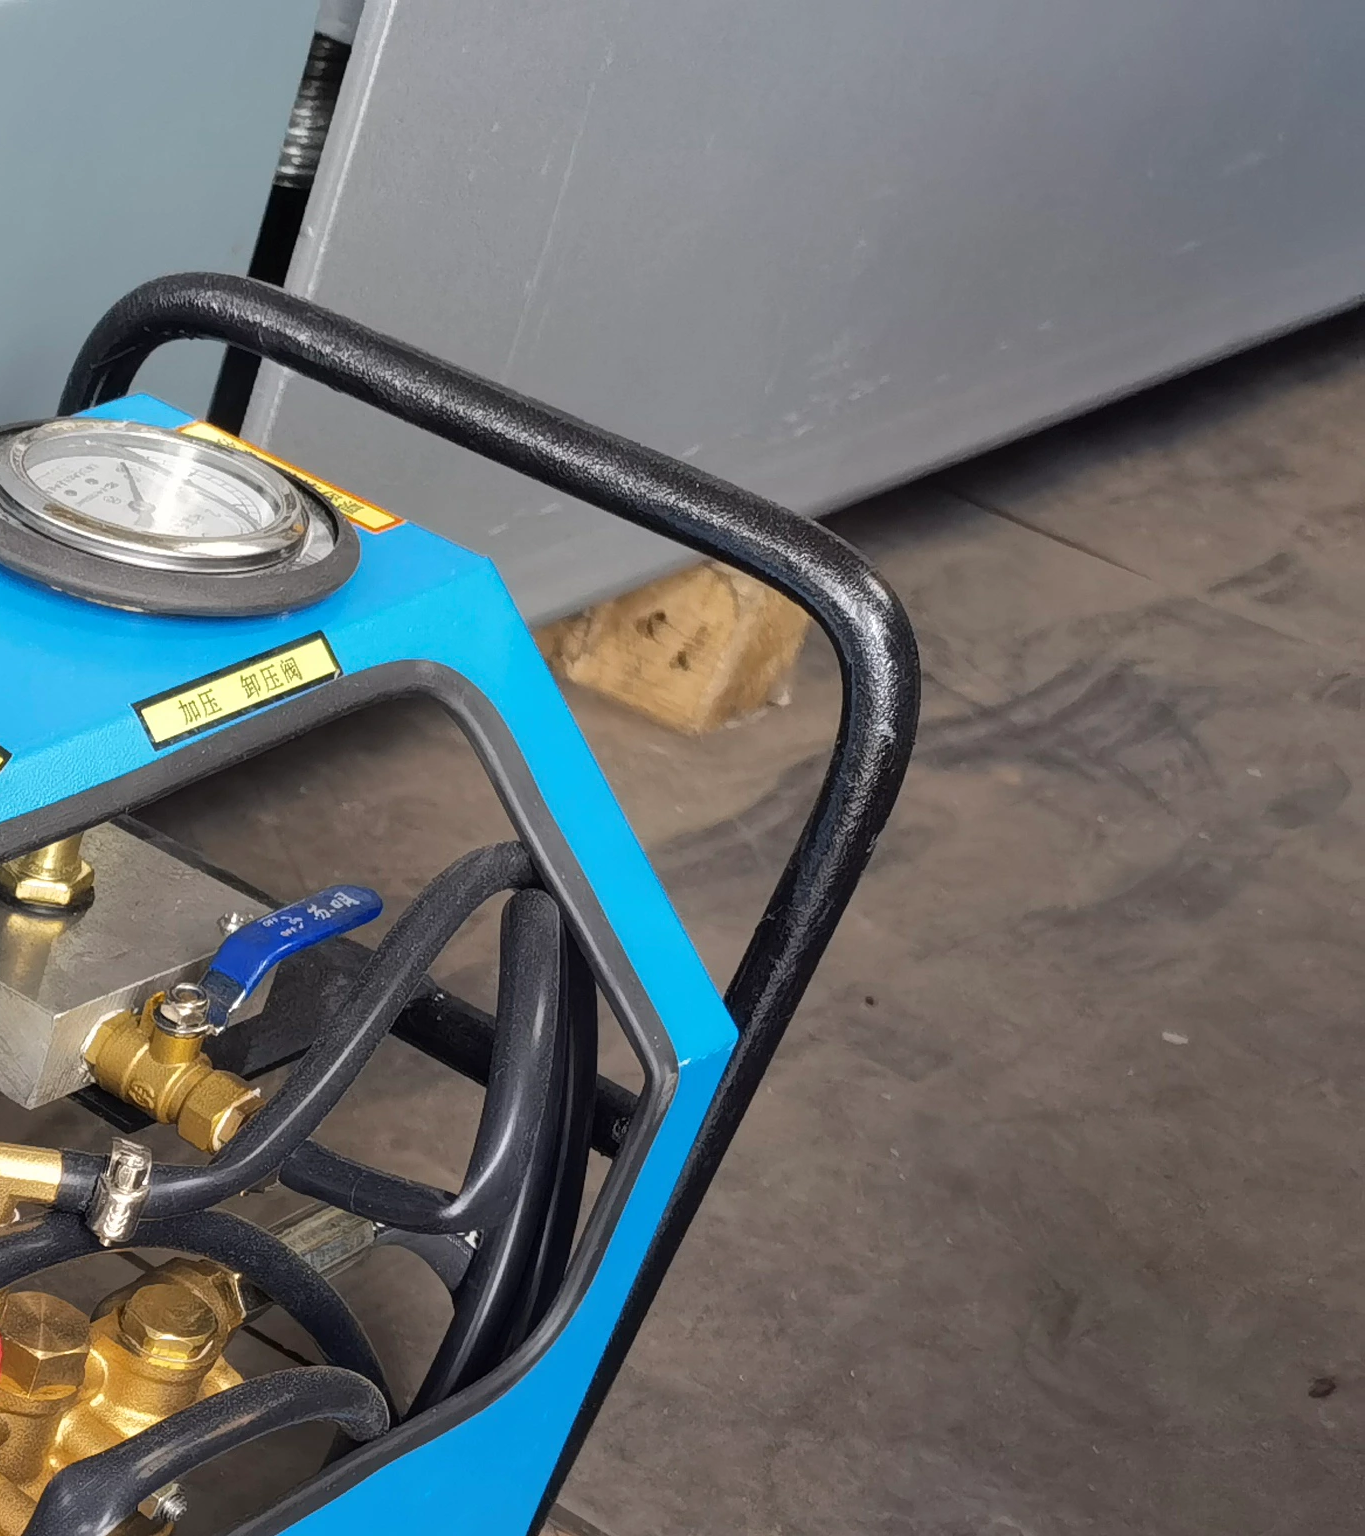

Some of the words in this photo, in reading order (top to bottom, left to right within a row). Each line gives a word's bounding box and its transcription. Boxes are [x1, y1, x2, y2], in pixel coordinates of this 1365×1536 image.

[178, 688, 222, 725] 加压
[240, 656, 304, 699] 卸压阀
